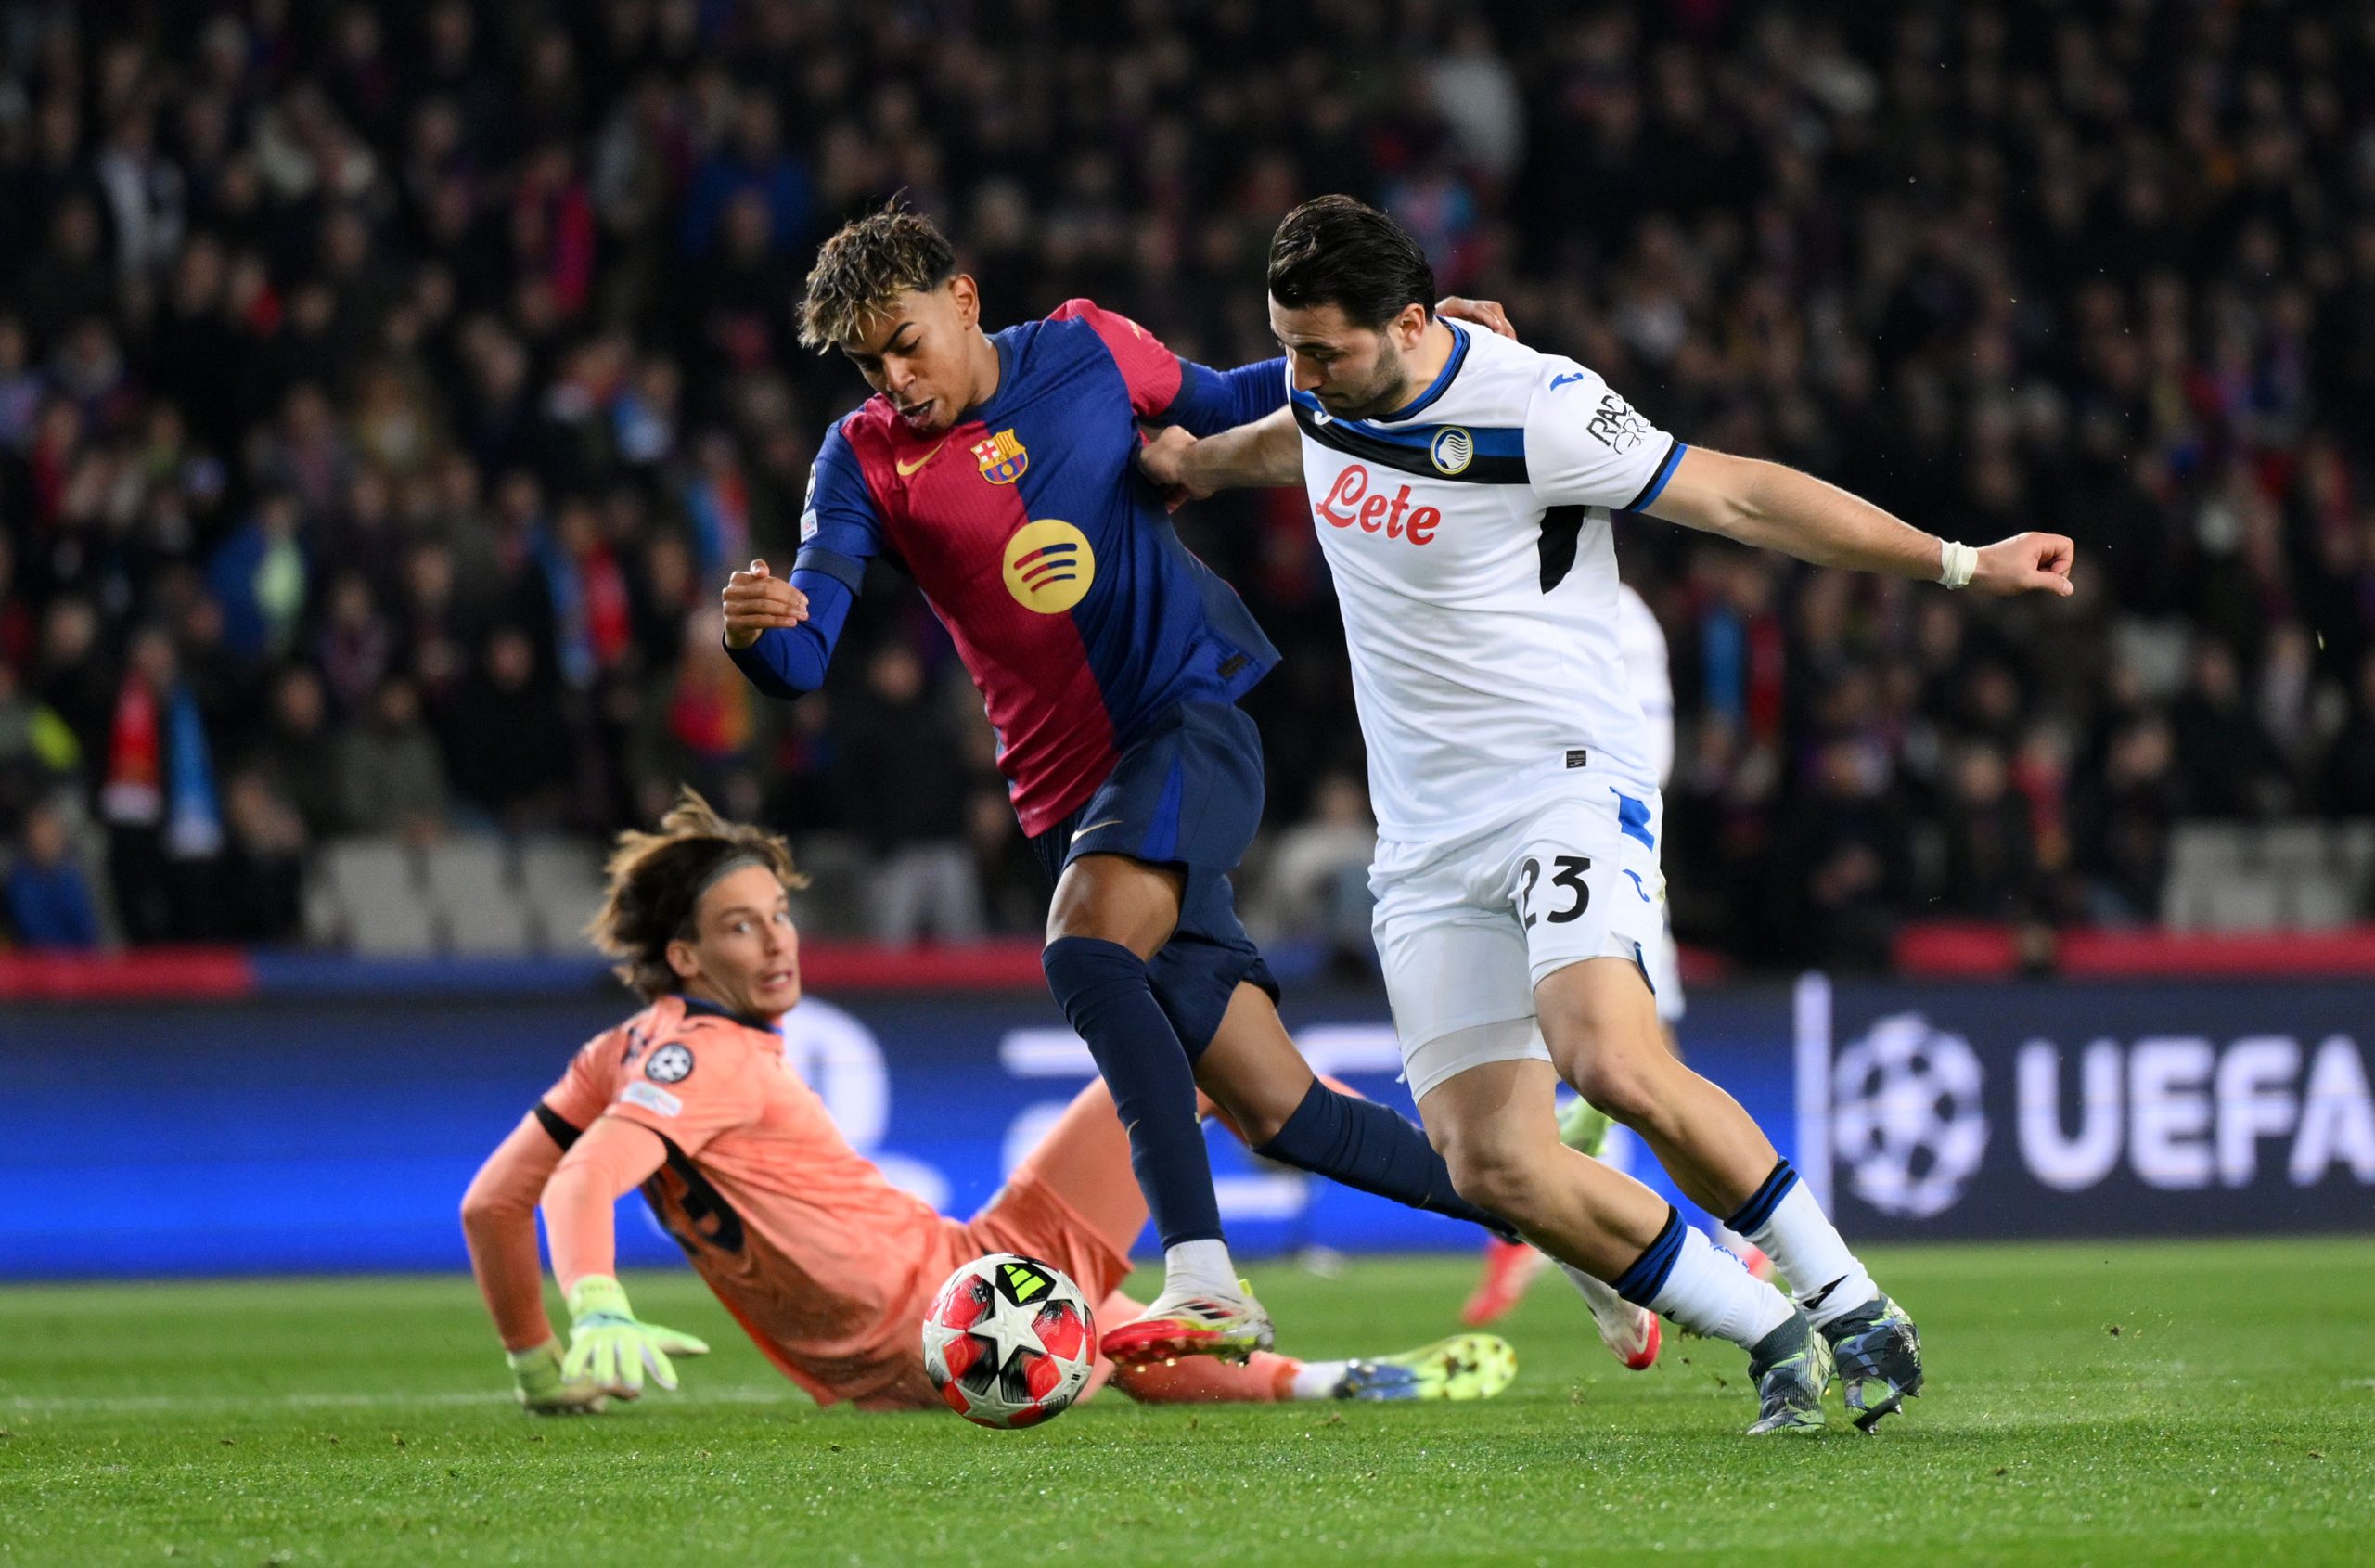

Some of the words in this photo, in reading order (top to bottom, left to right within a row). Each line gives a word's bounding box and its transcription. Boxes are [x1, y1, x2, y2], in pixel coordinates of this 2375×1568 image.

[1585, 393, 1629, 447] RAD
[1315, 464, 1441, 546] Lete
[1521, 855, 1591, 932] 23
[2016, 1032, 2375, 1192] UEFA
